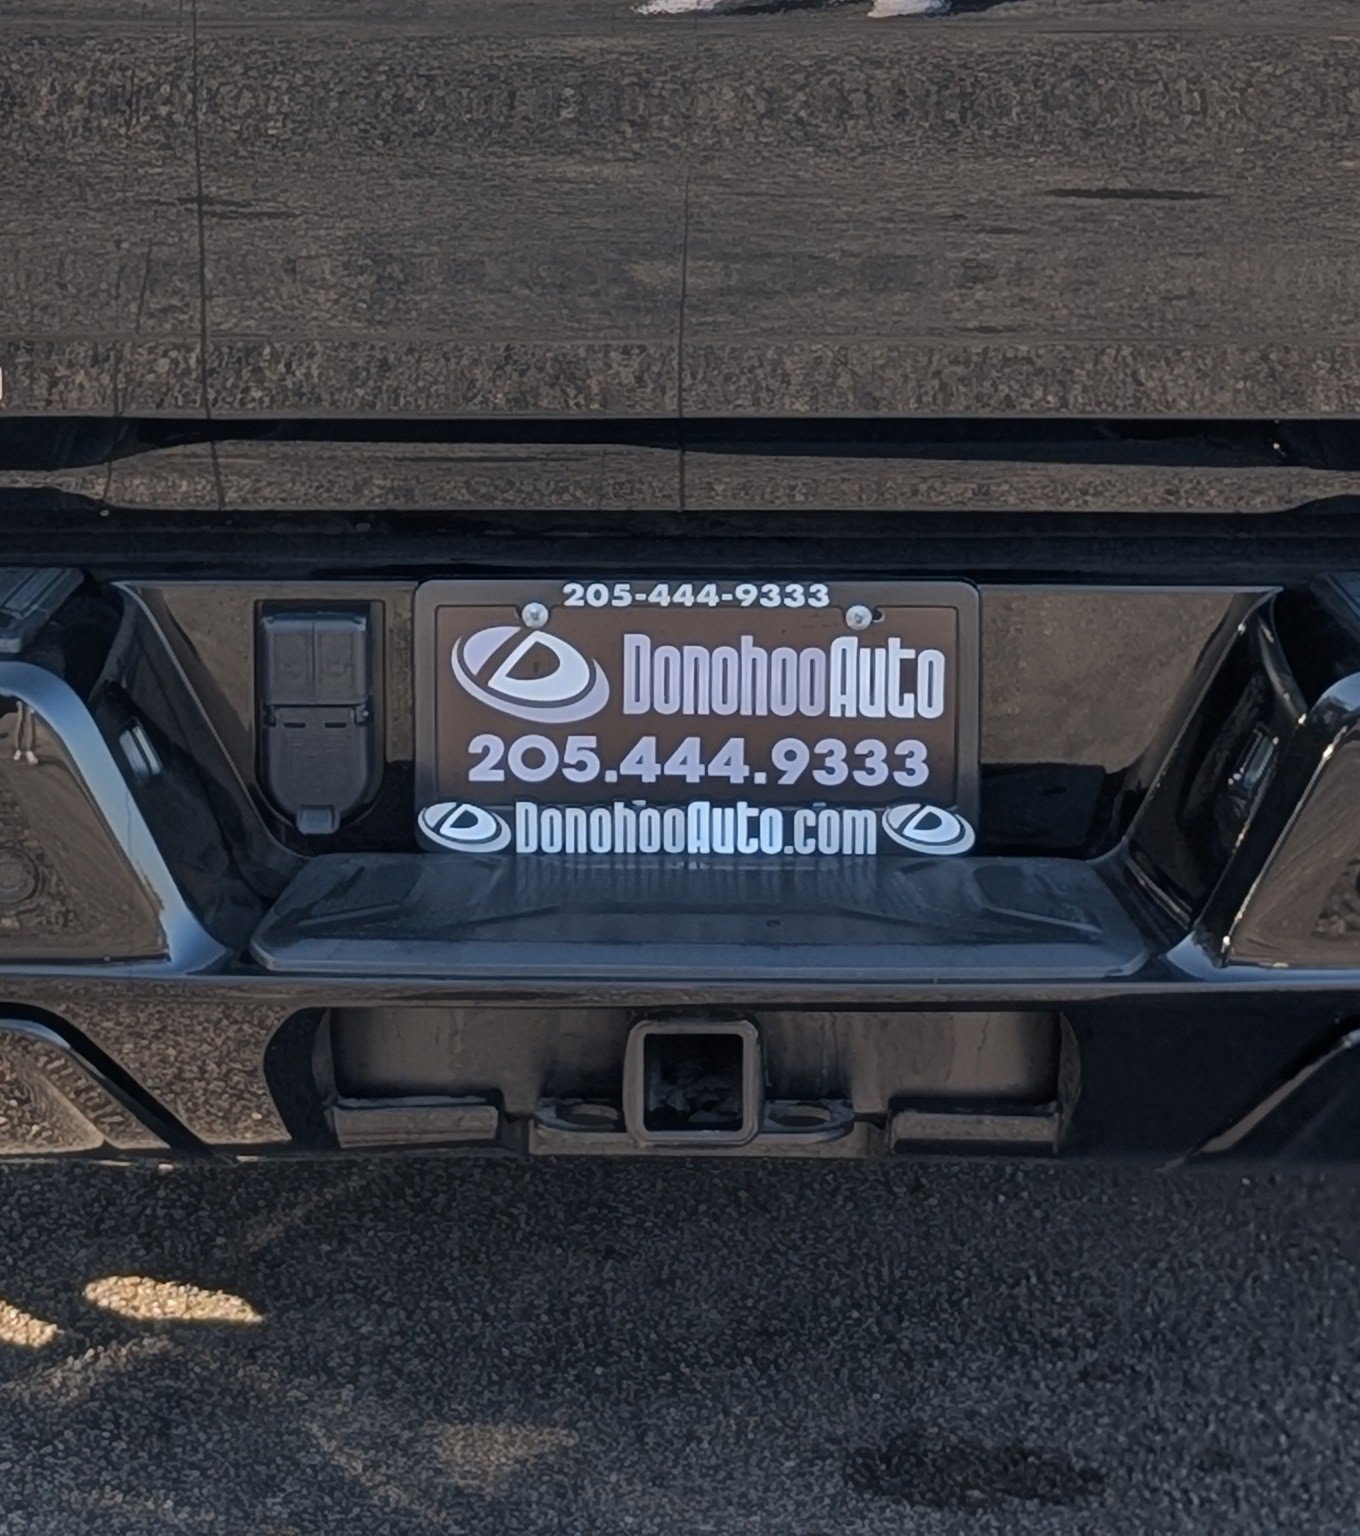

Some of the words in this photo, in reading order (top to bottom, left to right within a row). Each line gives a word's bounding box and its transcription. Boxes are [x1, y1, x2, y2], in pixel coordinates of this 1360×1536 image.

[562, 583, 830, 607] 205-444-9333
[623, 633, 945, 719] DonohooAuto
[467, 734, 930, 787] 205.444.9333
[516, 801, 877, 855] DonohooAuto.com
